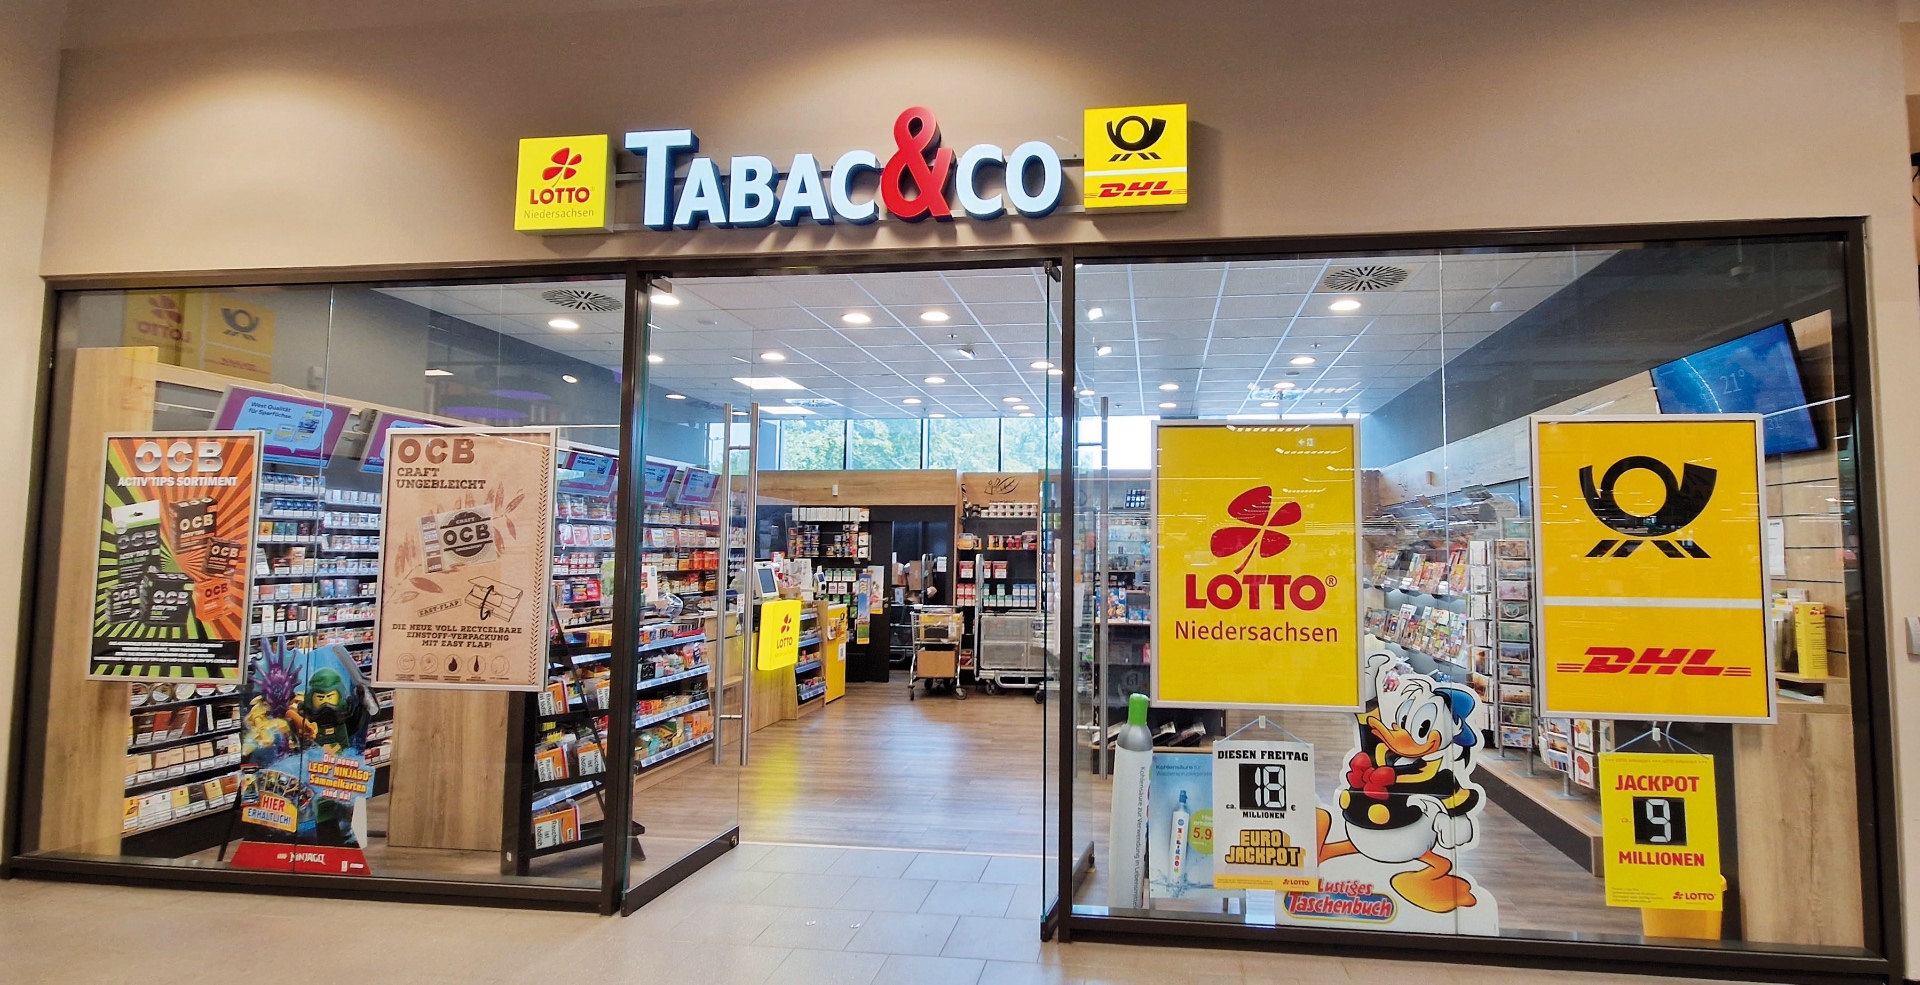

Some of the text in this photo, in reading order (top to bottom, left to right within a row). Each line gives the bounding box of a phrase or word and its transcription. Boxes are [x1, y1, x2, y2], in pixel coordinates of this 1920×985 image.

[529, 186, 590, 205] LOTTO
[1098, 180, 1173, 198] DHL
[523, 208, 594, 219] Niedersachsen
[248, 407, 258, 415] für
[267, 403, 292, 412] Qualität
[135, 441, 224, 473] OCB
[397, 438, 476, 464] OCB
[396, 467, 440, 478] CRAFT
[176, 476, 238, 487] SORTIMENT
[396, 479, 487, 490] UNGEBLEICHT
[180, 513, 214, 531] OCB
[117, 530, 158, 550] OCB
[443, 523, 491, 546] OCB
[211, 545, 239, 558] OCB
[112, 588, 138, 602] OCB
[152, 590, 189, 605] OCB
[204, 583, 229, 598] OCB
[406, 631, 510, 641] EINSTOFF-VERPACKUNG
[460, 625, 523, 634] RECYCELBARE
[1175, 619, 1339, 643] Niedersachsen
[441, 640, 464, 648] EASY
[466, 641, 492, 649] FLAP!
[776, 636, 793, 649] LOTTO
[1583, 646, 1727, 678] DHL
[323, 753, 359, 768] Die neuen
[1217, 750, 1309, 761] DIESEN FREITAG
[309, 774, 368, 794] Sammelkarten
[1254, 766, 1286, 808] 18
[1614, 774, 1700, 792] JACKPOT
[322, 788, 338, 799] sind
[261, 795, 286, 812] HIER
[1242, 811, 1285, 819] MILLIONEN
[1645, 798, 1672, 844] 9
[1134, 817, 1143, 860] Verwendung
[1193, 827, 1213, 840] 5.9
[1240, 829, 1285, 847] EURO
[1225, 845, 1303, 867] JACKPOT
[1618, 851, 1706, 867] MILLIONEN
[1317, 878, 1374, 896] Lustiges
[1685, 892, 1715, 901] LOTTO
[1288, 891, 1393, 918] Taschenbuch
